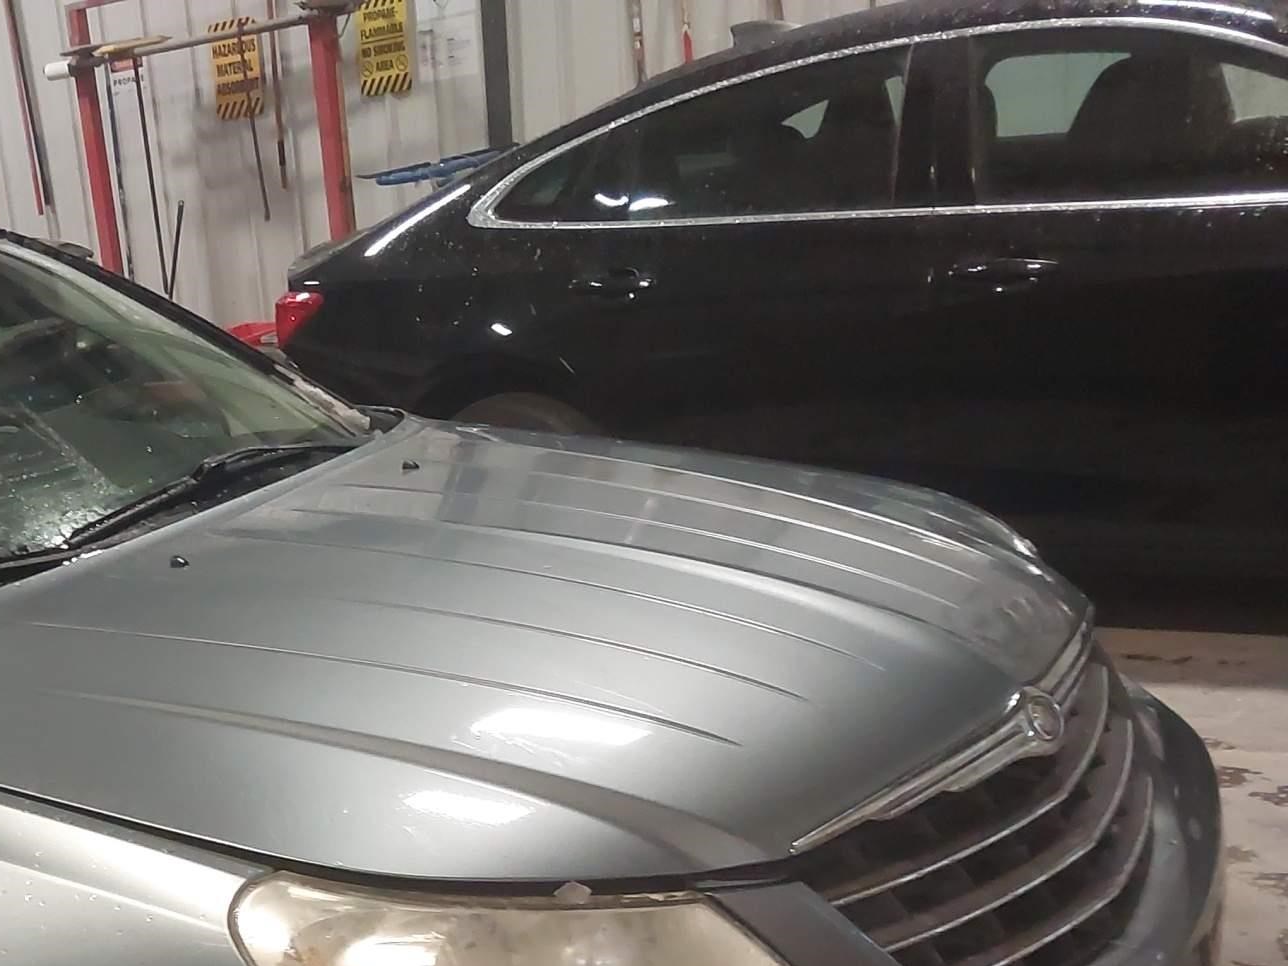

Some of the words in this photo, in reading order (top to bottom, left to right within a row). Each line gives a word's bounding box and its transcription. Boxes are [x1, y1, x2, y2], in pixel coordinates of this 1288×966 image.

[359, 21, 404, 41] FLAMMABLE
[361, 46, 372, 59] NO
[372, 40, 406, 57] SMOKING
[215, 58, 254, 78] MATERL
[374, 59, 395, 72] AREA
[112, 73, 145, 87] PROPAE
